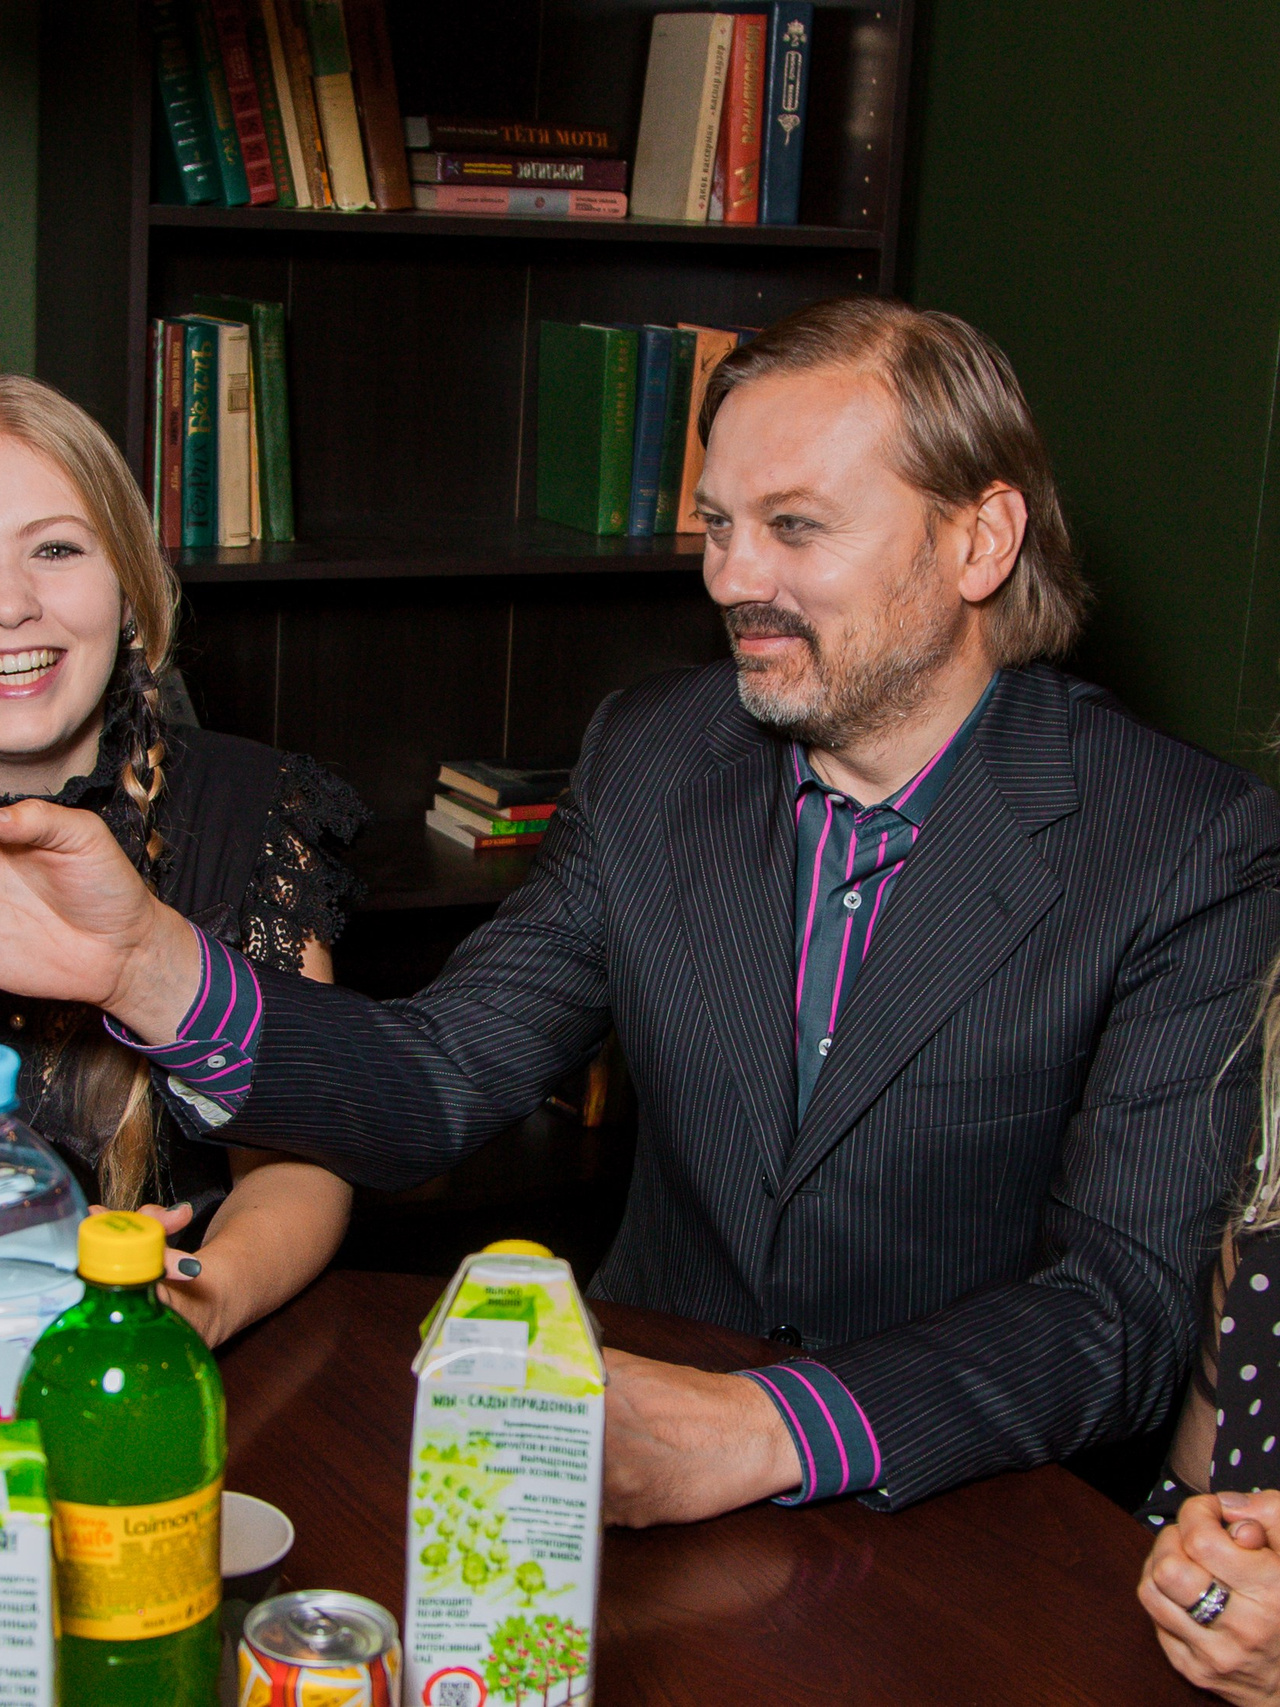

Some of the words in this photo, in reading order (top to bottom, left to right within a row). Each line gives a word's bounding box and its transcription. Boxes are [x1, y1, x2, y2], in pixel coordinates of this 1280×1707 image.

[500, 124, 550, 144] ТЁТЯ
[555, 129, 608, 148] МОТЯ
[469, 1394, 508, 1411] САДЫ
